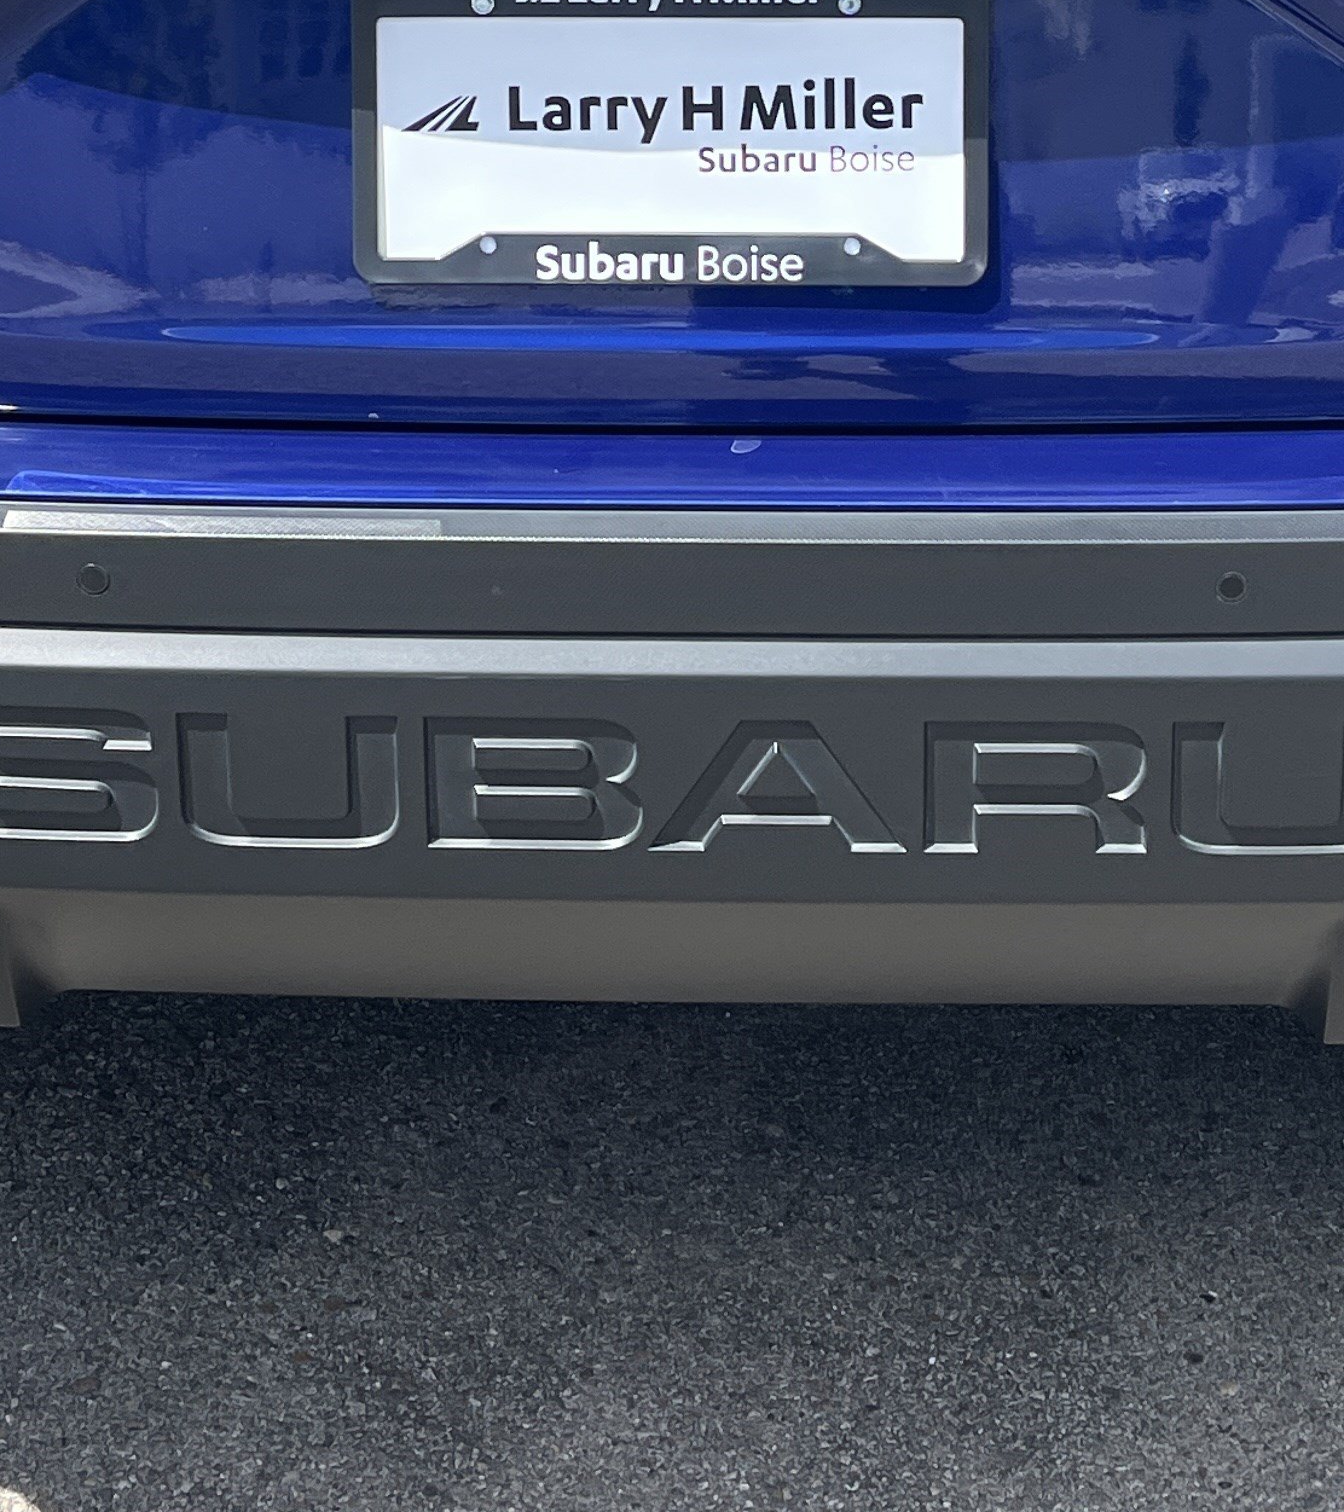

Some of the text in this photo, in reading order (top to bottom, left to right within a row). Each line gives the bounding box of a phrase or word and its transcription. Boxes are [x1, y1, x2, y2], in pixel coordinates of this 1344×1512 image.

[507, 77, 924, 144] Larry H Miller
[697, 144, 915, 174] Subaru Boise
[535, 243, 804, 283] Subaru Boise
